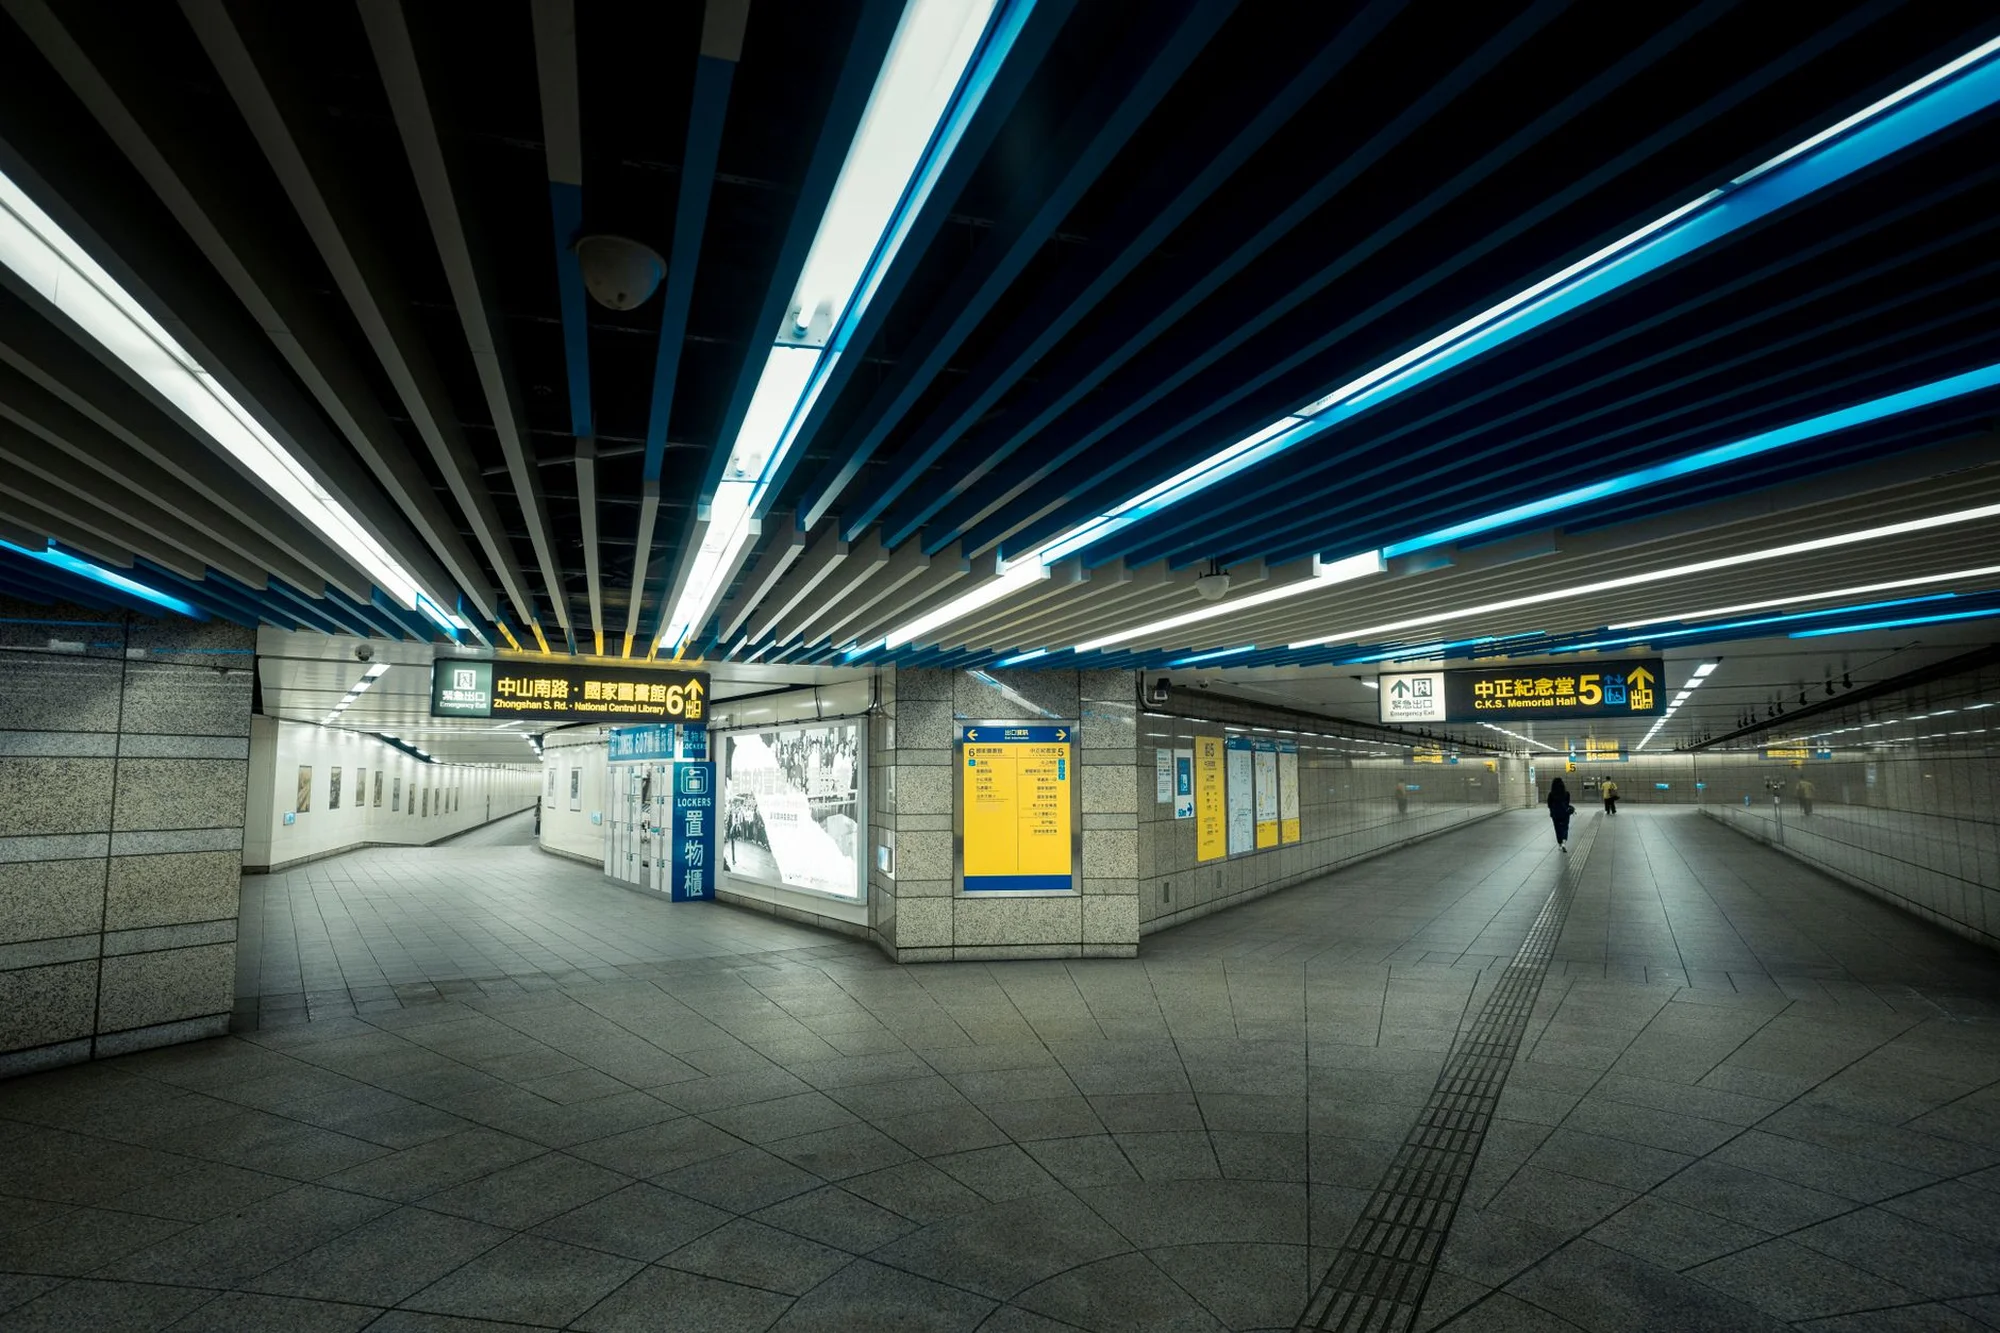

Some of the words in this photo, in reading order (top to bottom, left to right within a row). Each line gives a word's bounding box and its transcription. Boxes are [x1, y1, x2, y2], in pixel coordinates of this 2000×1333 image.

[1474, 677, 1575, 699] 中正紀念堂
[1578, 674, 1602, 705] 5
[497, 677, 569, 699] 中山南路
[584, 680, 666, 703] 國家圖書館
[666, 685, 684, 715] 6
[1631, 689, 1653, 710] 出口
[440, 701, 475, 710] Emergency
[493, 698, 542, 711] Zhongshan
[543, 701, 552, 710] S.
[553, 701, 568, 710] Rd.
[574, 702, 608, 712] National
[608, 703, 637, 713] Central
[638, 704, 665, 716] Library
[1391, 699, 1432, 710] 緊急出口
[1474, 699, 1506, 709] C.K.S.
[1507, 697, 1554, 708] Memorial
[1556, 696, 1577, 706] Hall
[968, 747, 975, 757] 6
[1057, 747, 1064, 757] 5
[1569, 763, 1576, 772] 5
[677, 797, 711, 807] LOCKERS
[684, 810, 704, 898] 置物櫃
